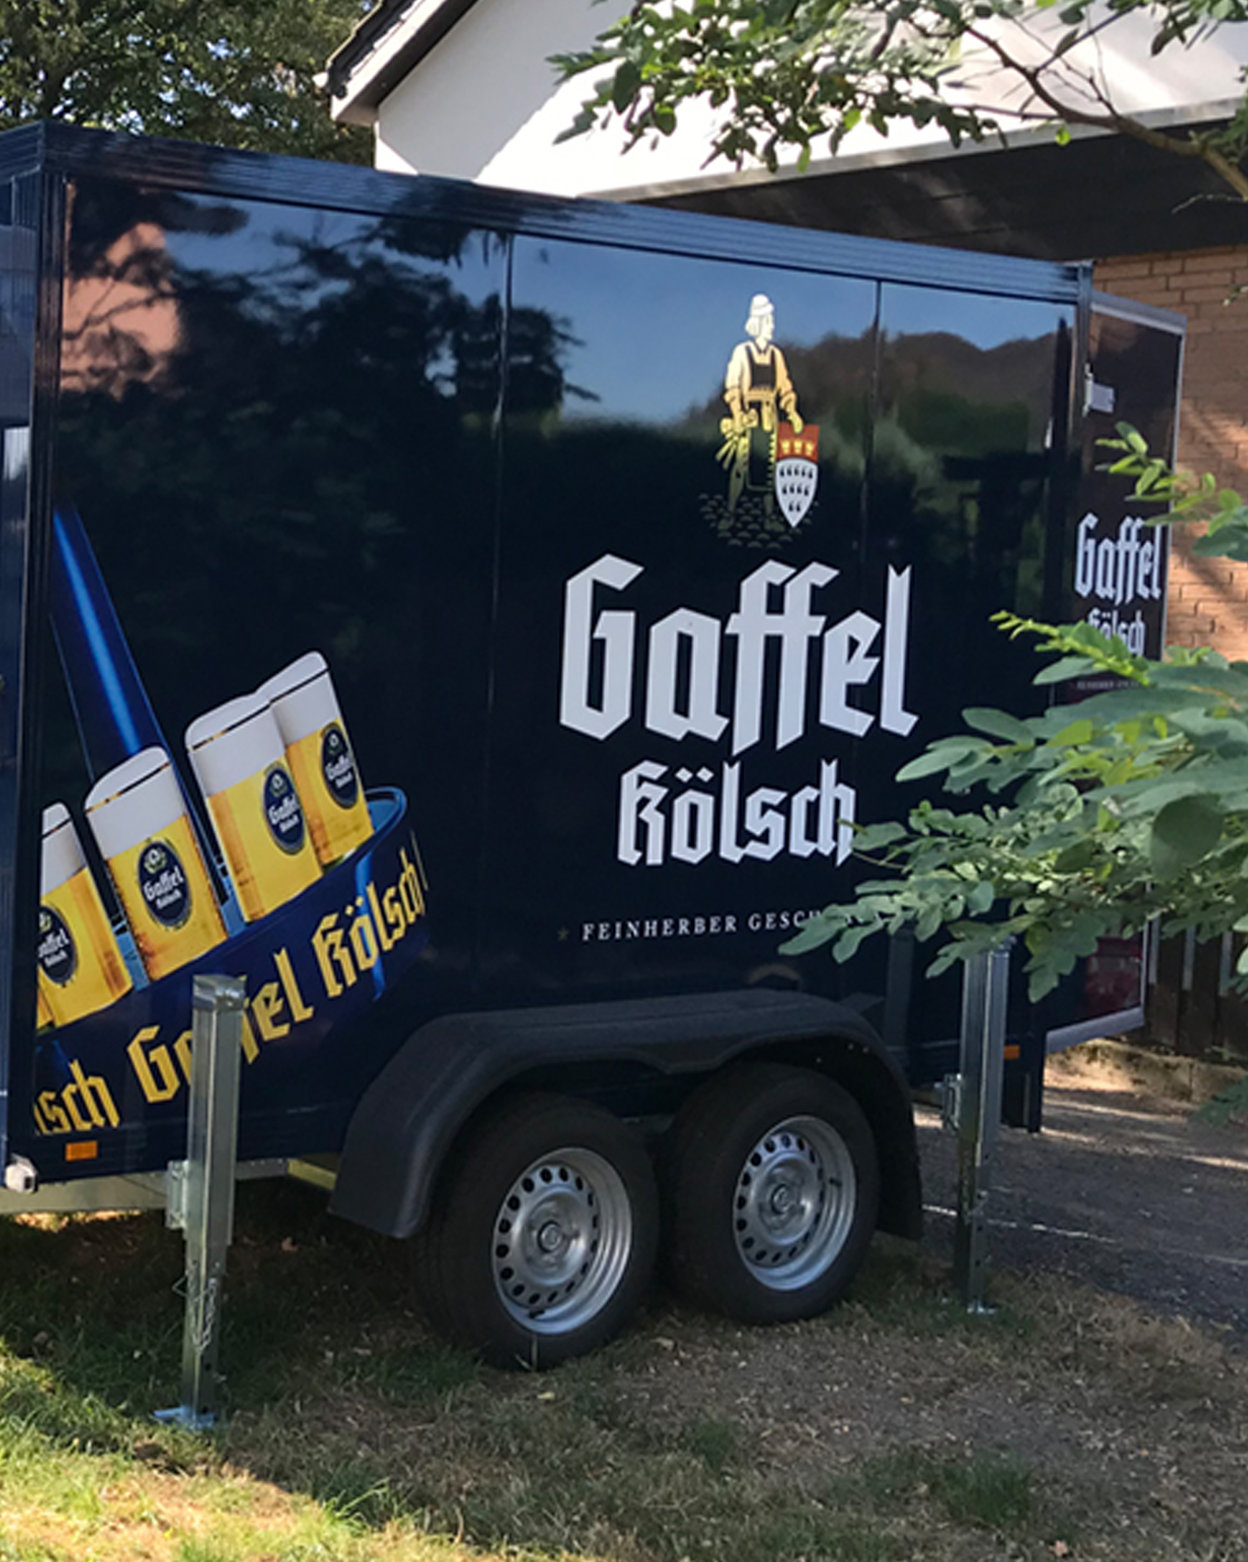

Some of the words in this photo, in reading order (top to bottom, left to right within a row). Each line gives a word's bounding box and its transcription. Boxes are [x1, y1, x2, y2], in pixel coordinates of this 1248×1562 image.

[1074, 512, 1163, 606] Gaffel
[559, 553, 920, 757] Gaffel
[618, 758, 857, 867] Kölsch
[143, 865, 184, 902] Gaffel
[312, 848, 426, 998] Kölsch
[582, 914, 738, 941] FEINHERBER
